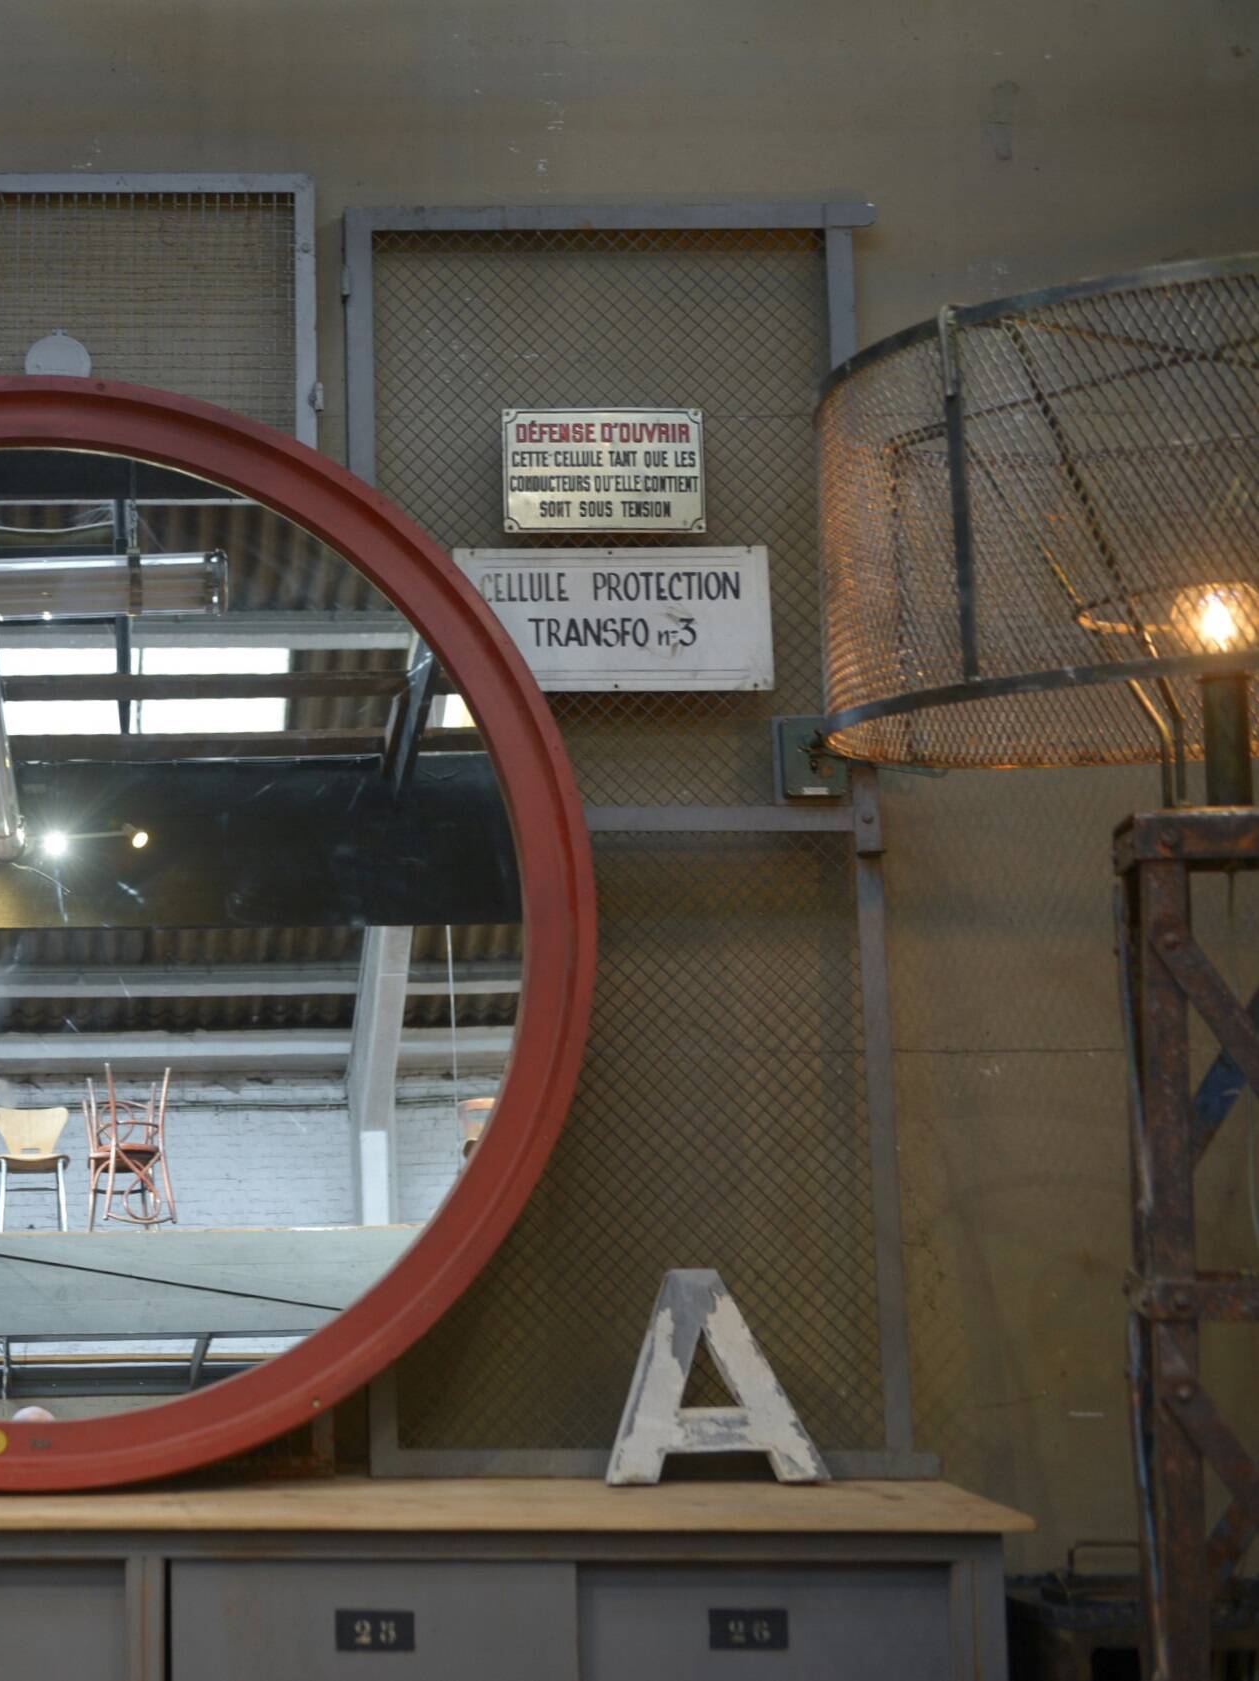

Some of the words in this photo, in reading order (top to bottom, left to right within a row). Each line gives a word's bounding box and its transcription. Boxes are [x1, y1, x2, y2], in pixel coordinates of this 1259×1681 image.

[515, 420, 597, 443] DÉFENSE
[600, 423, 691, 443] D'OUVRIR
[512, 451, 549, 468] CETTE
[554, 451, 604, 468] CELLULE
[609, 451, 637, 468] TANT
[644, 451, 668, 468] QUE
[674, 451, 696, 468] LES
[509, 475, 590, 492] CONDUCTEURS
[594, 475, 641, 492] QU'ELLE
[644, 475, 699, 492] CONTIENT
[539, 501, 572, 518] SONT
[579, 501, 613, 518] SOUS
[621, 501, 671, 518] TENSION
[480, 571, 570, 602] CELLULE
[593, 570, 740, 601] PROTECTION
[528, 617, 649, 648] TRANSFO
[606, 1268, 831, 1486] A
[727, 1619, 772, 1644] 26
